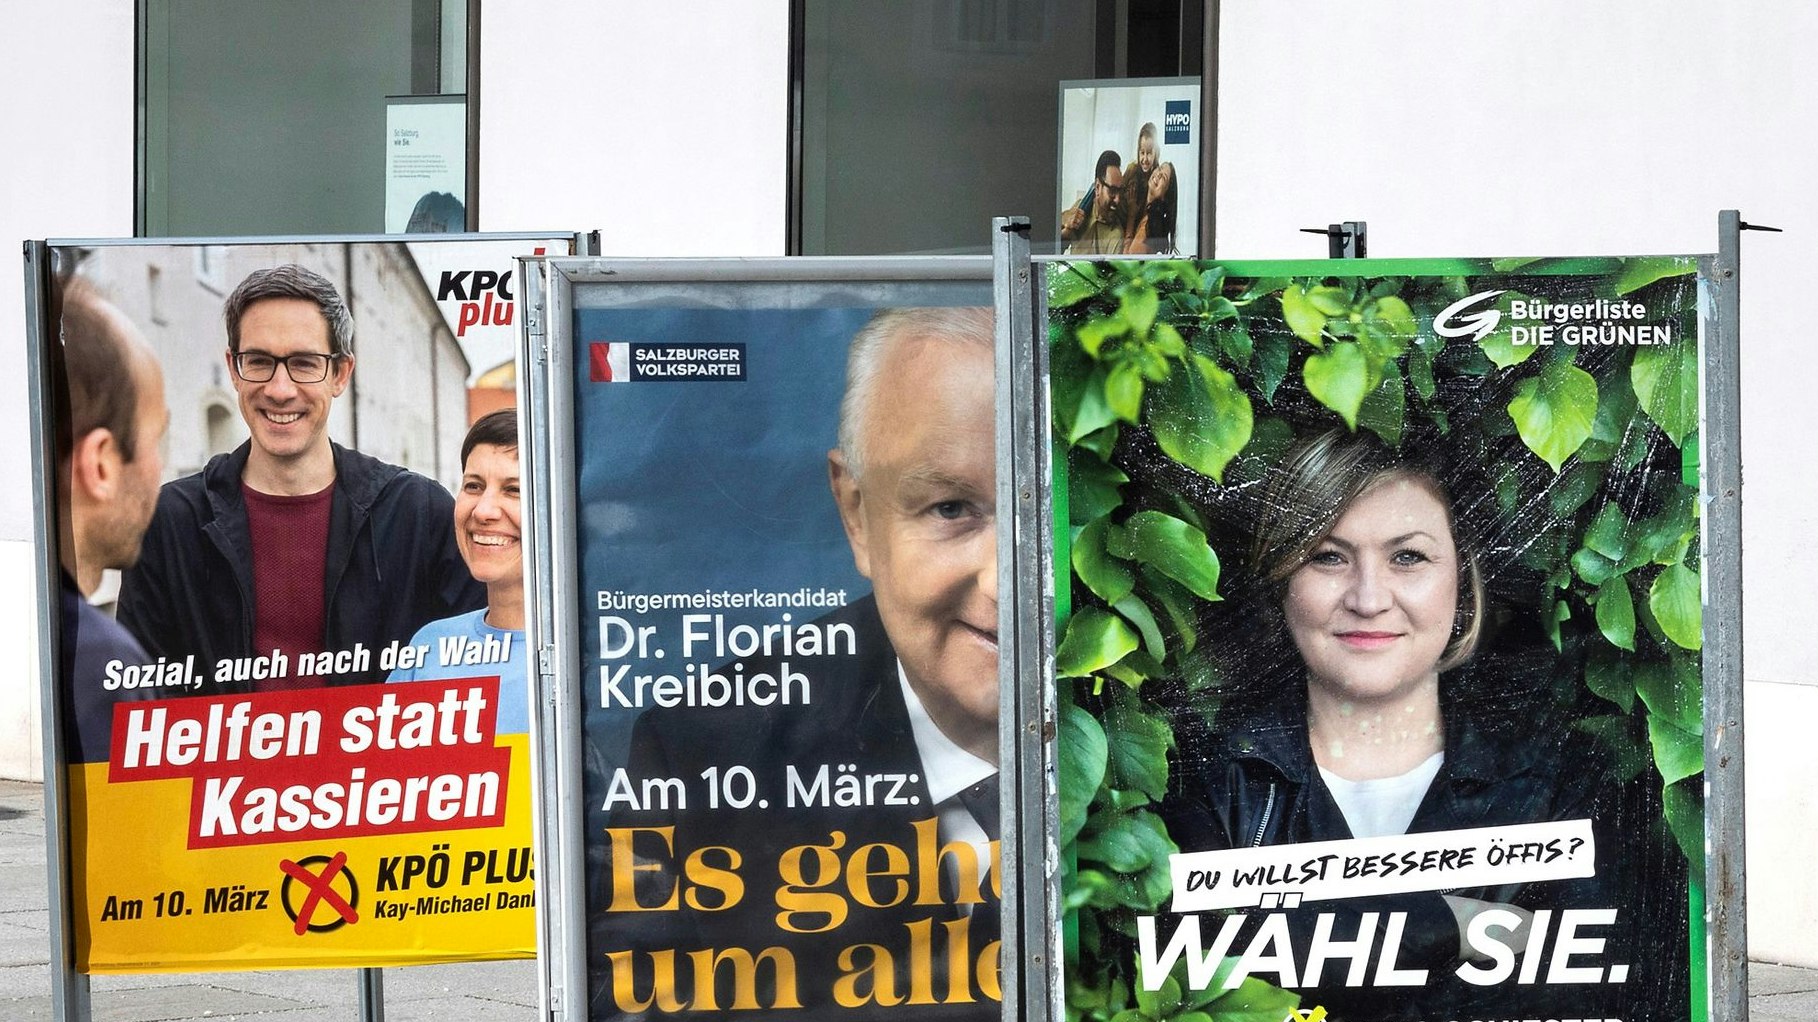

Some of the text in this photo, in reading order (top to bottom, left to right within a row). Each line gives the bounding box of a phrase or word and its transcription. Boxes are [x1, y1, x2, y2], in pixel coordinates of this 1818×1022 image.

[1166, 113, 1190, 126] HYPO
[457, 291, 514, 337] plu
[1511, 300, 1646, 324] Bürgerliste
[1511, 321, 1672, 346] DIE GRÜNEN
[635, 348, 740, 362] SALZBURGER
[635, 362, 741, 377] VOLKSPARTEI
[597, 588, 847, 613] Bürgermeisterkandidat
[599, 612, 856, 660] Dr. Florian
[103, 633, 512, 691] Sozial, auch nach der Wahl
[600, 662, 811, 709] Kreibich
[123, 687, 487, 769] Helfen statt
[199, 767, 500, 838] Kassieren
[602, 763, 920, 811] Am 10. März:
[376, 843, 536, 892] KPÖ PLU
[605, 825, 745, 913] Es
[1186, 837, 1586, 893] DU WILLST BESSERE ÖFFIS?
[101, 885, 269, 922] Am 10. März
[375, 890, 536, 921] Kay-Michael Dan
[605, 916, 1003, 1014] um all
[1136, 892, 1631, 992] WÄHL SIE.
